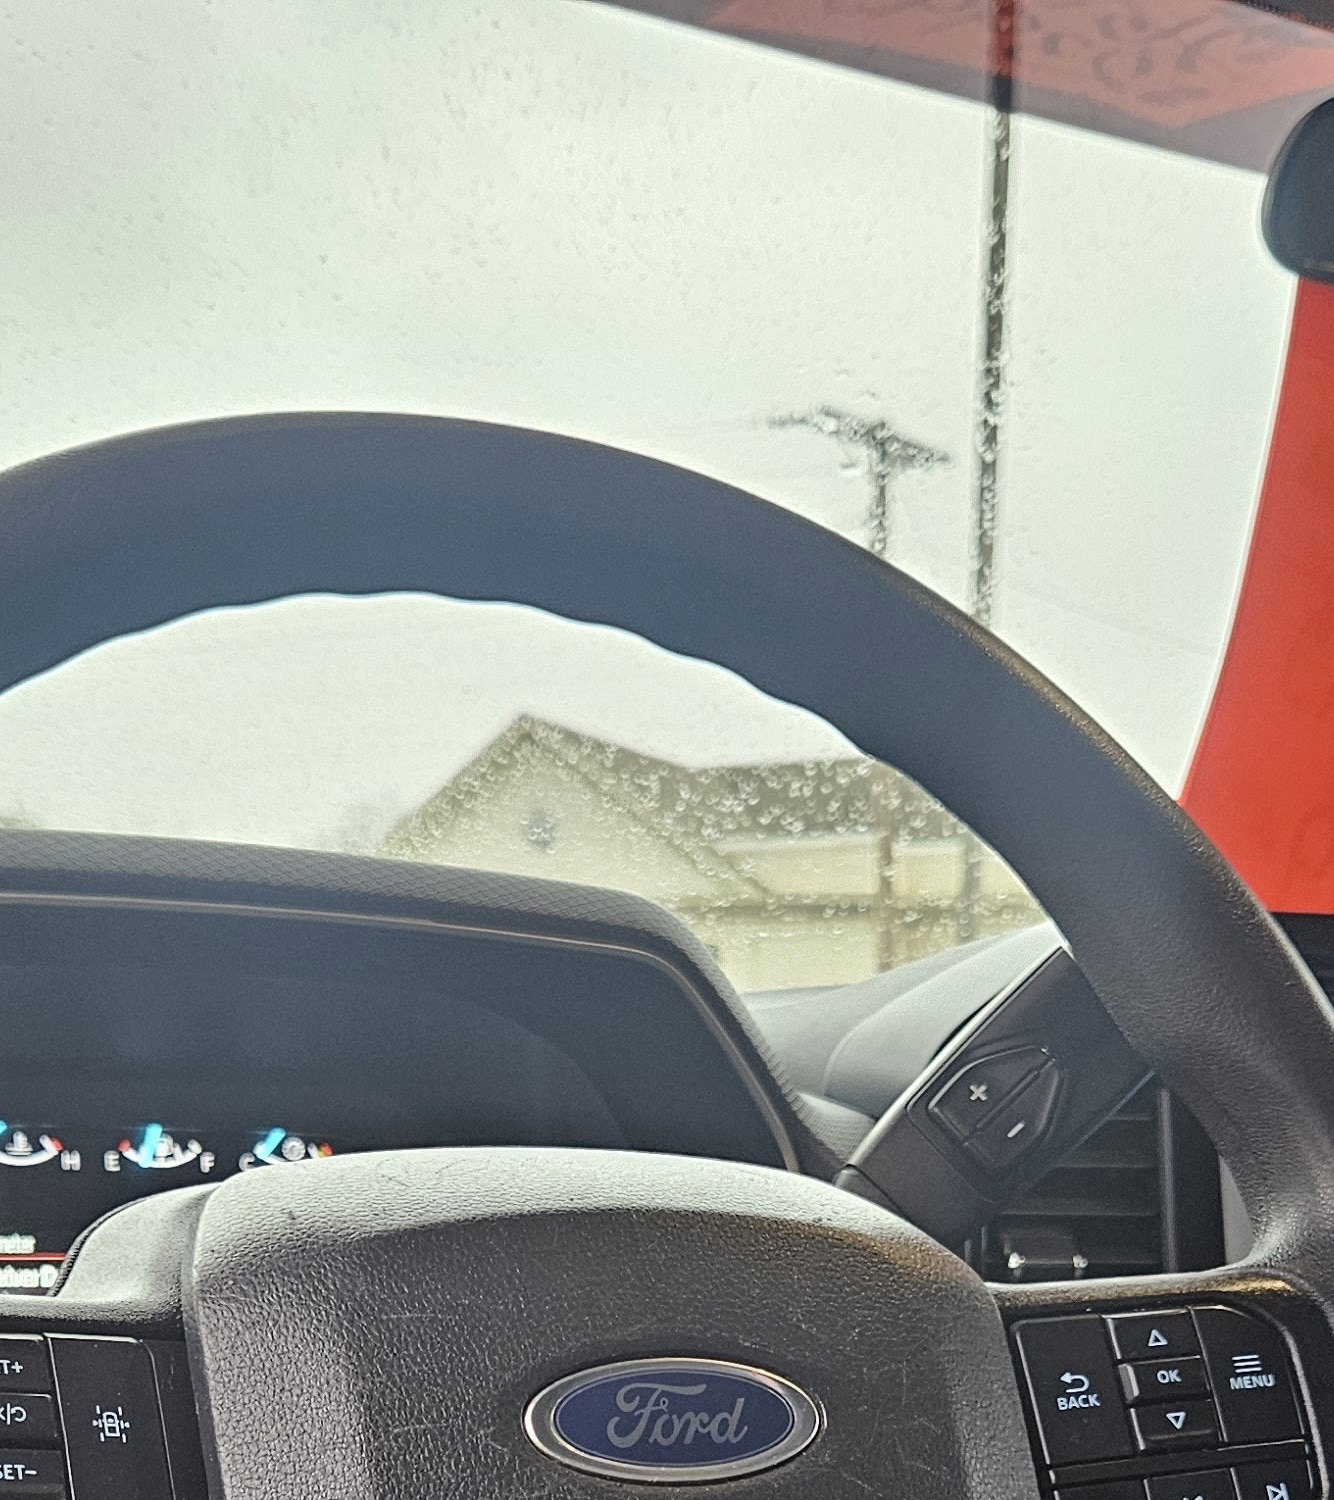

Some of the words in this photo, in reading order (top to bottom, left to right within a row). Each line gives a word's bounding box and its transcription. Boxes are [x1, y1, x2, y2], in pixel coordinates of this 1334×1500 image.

[61, 1150, 81, 1170] H
[104, 1150, 121, 1172] E
[200, 1151, 215, 1173] F
[239, 1152, 256, 1172] C
[1155, 1368, 1182, 1385] OK
[1229, 1373, 1276, 1391] MENU
[1056, 1393, 1101, 1412] BACK
[606, 1382, 748, 1449] Ford
